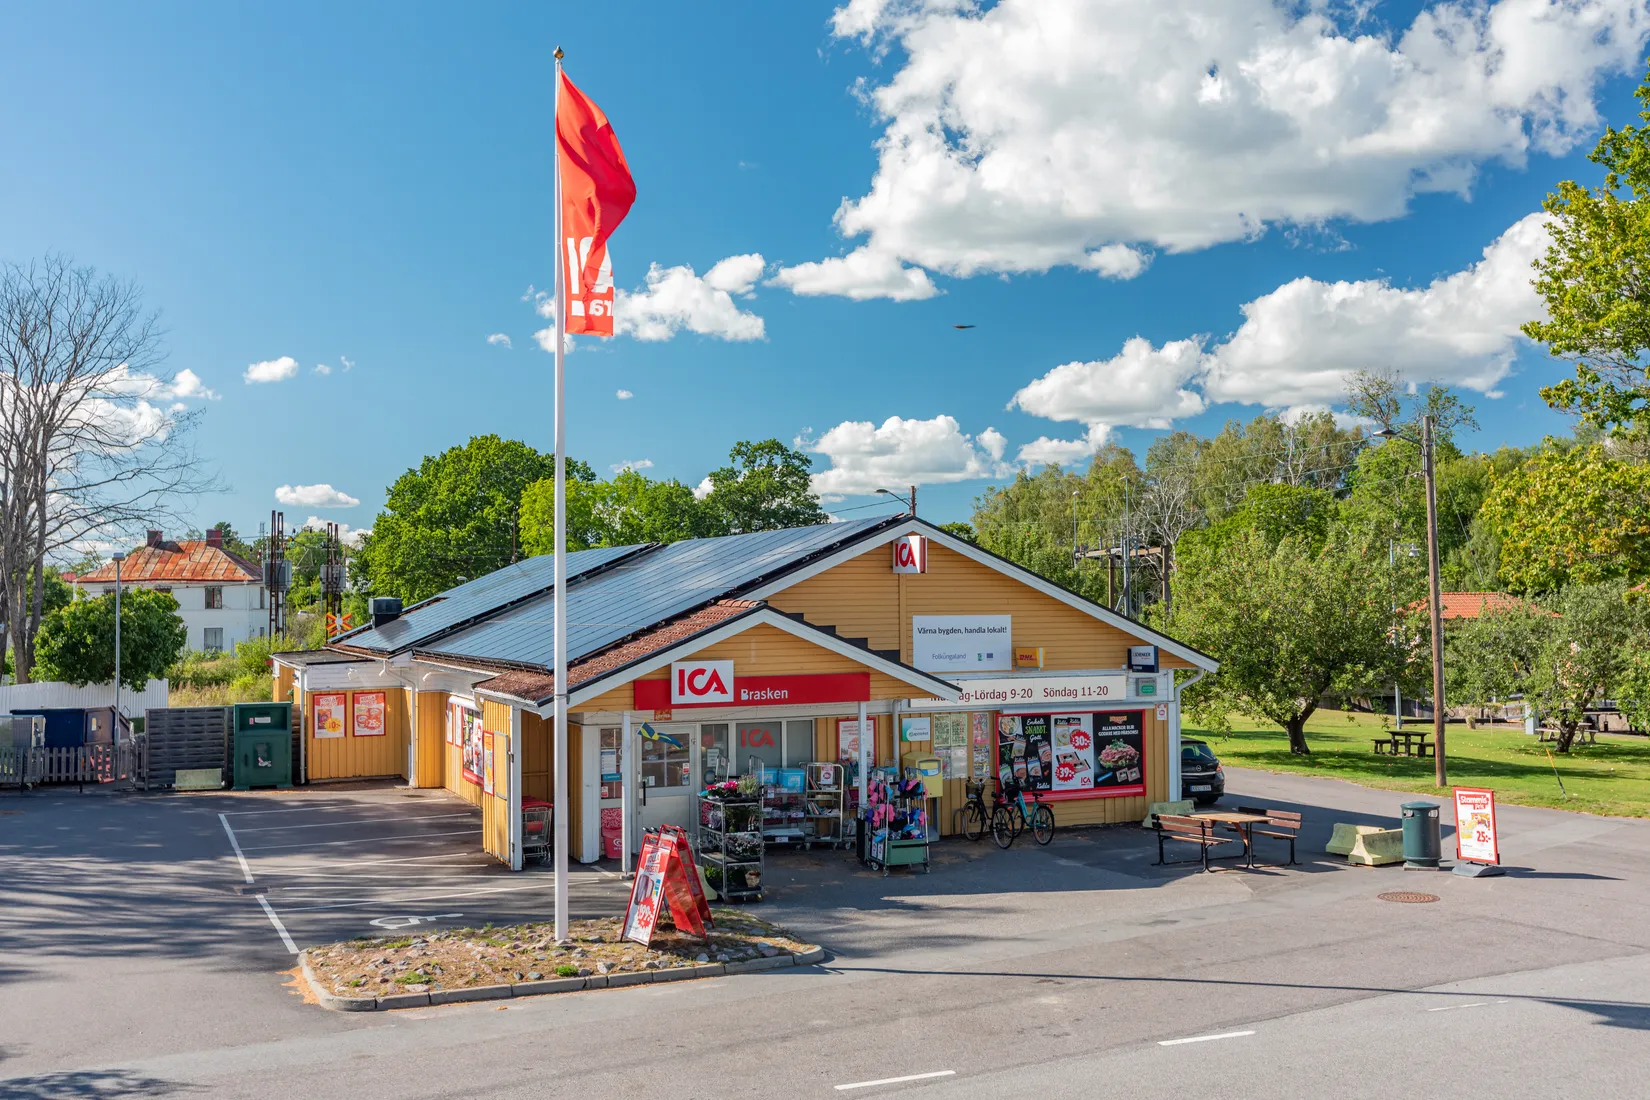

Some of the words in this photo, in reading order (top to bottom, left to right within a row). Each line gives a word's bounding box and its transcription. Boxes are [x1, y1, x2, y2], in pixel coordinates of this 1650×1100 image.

[895, 542, 917, 568] ICA
[917, 626, 937, 635] Värna
[938, 626, 964, 636] bygden,
[964, 626, 986, 634] handla
[987, 626, 1007, 634] lokalt!
[678, 667, 729, 697] ICA
[740, 687, 789, 701] Brasken
[931, 688, 1007, 702] ag-Lördag
[1010, 687, 1033, 699] 9-20
[1043, 687, 1078, 699] Söndag
[1081, 685, 1109, 697] 11-20
[741, 728, 776, 748] ICA
[1476, 830, 1491, 843] 25:-
